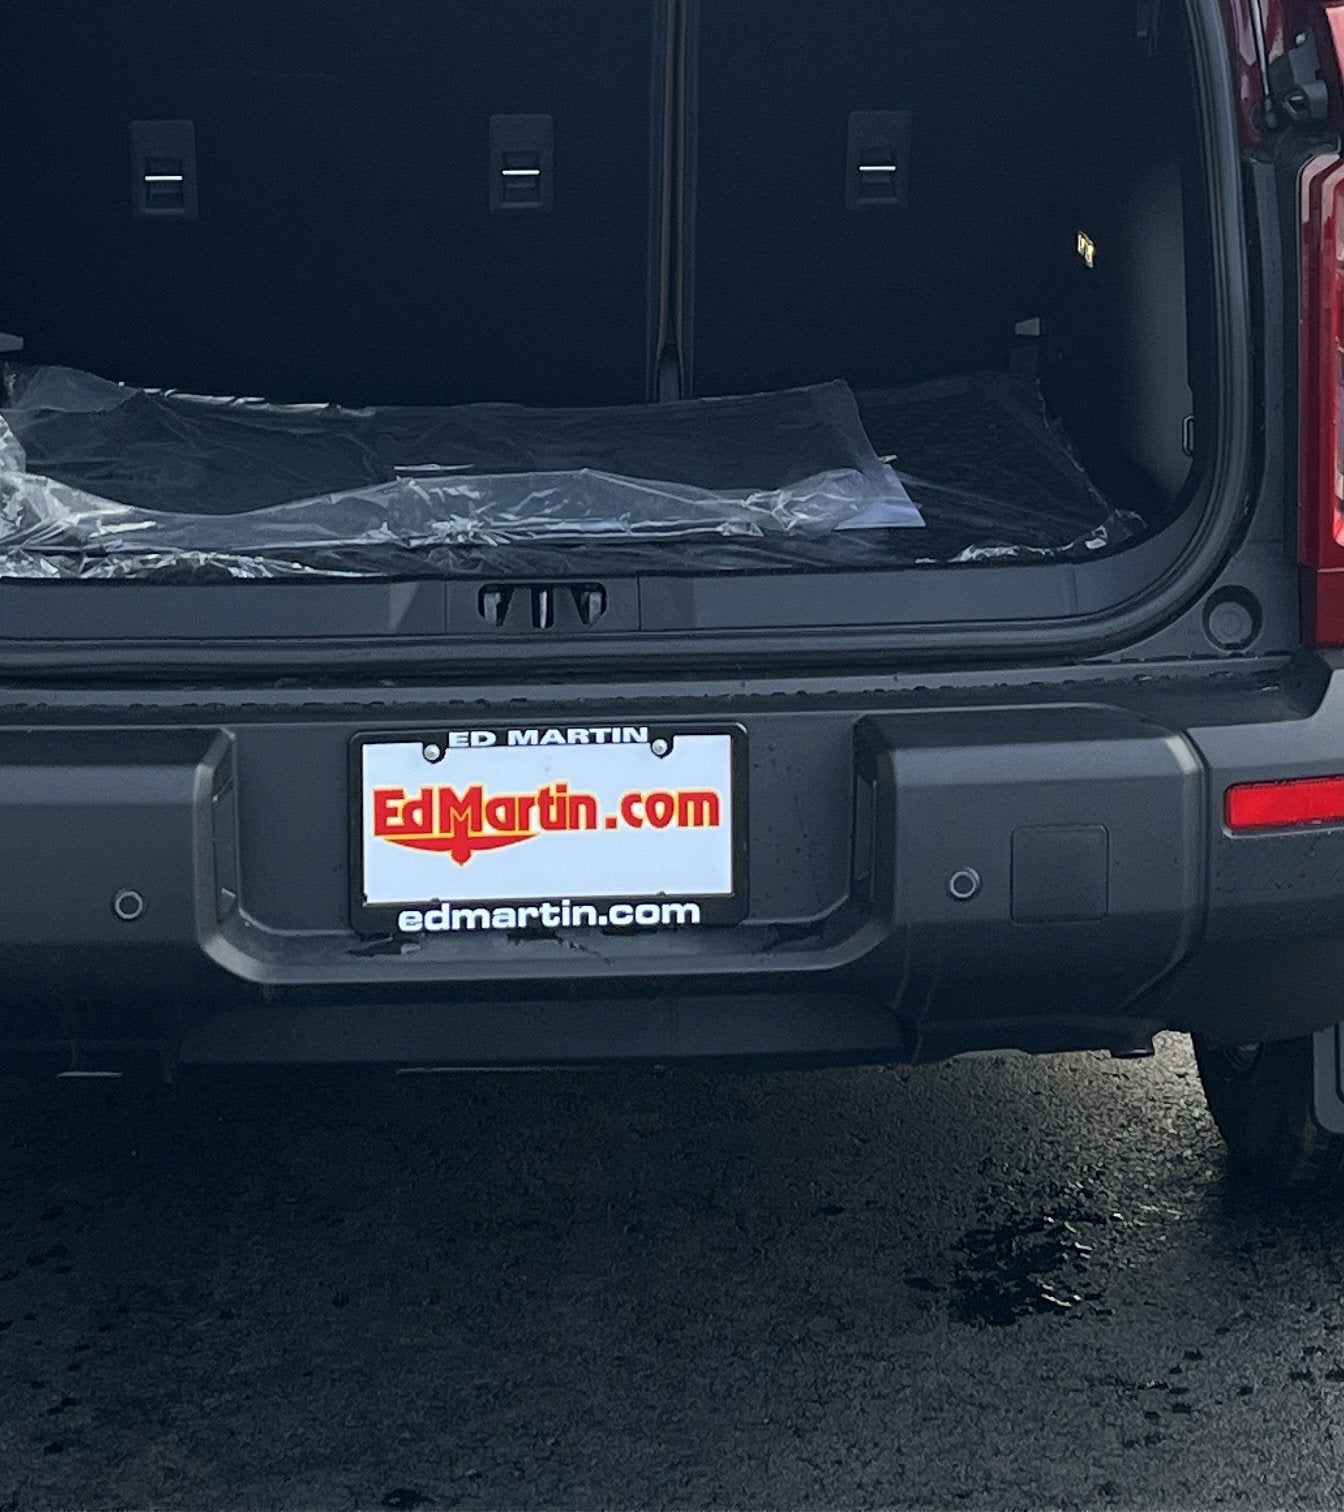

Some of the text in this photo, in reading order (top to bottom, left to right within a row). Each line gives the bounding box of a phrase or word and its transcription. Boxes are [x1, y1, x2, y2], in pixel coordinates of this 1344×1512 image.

[448, 727, 649, 748] ED MARTIN
[373, 783, 720, 838] EdMartin.com
[398, 899, 701, 933] edmartin.com
